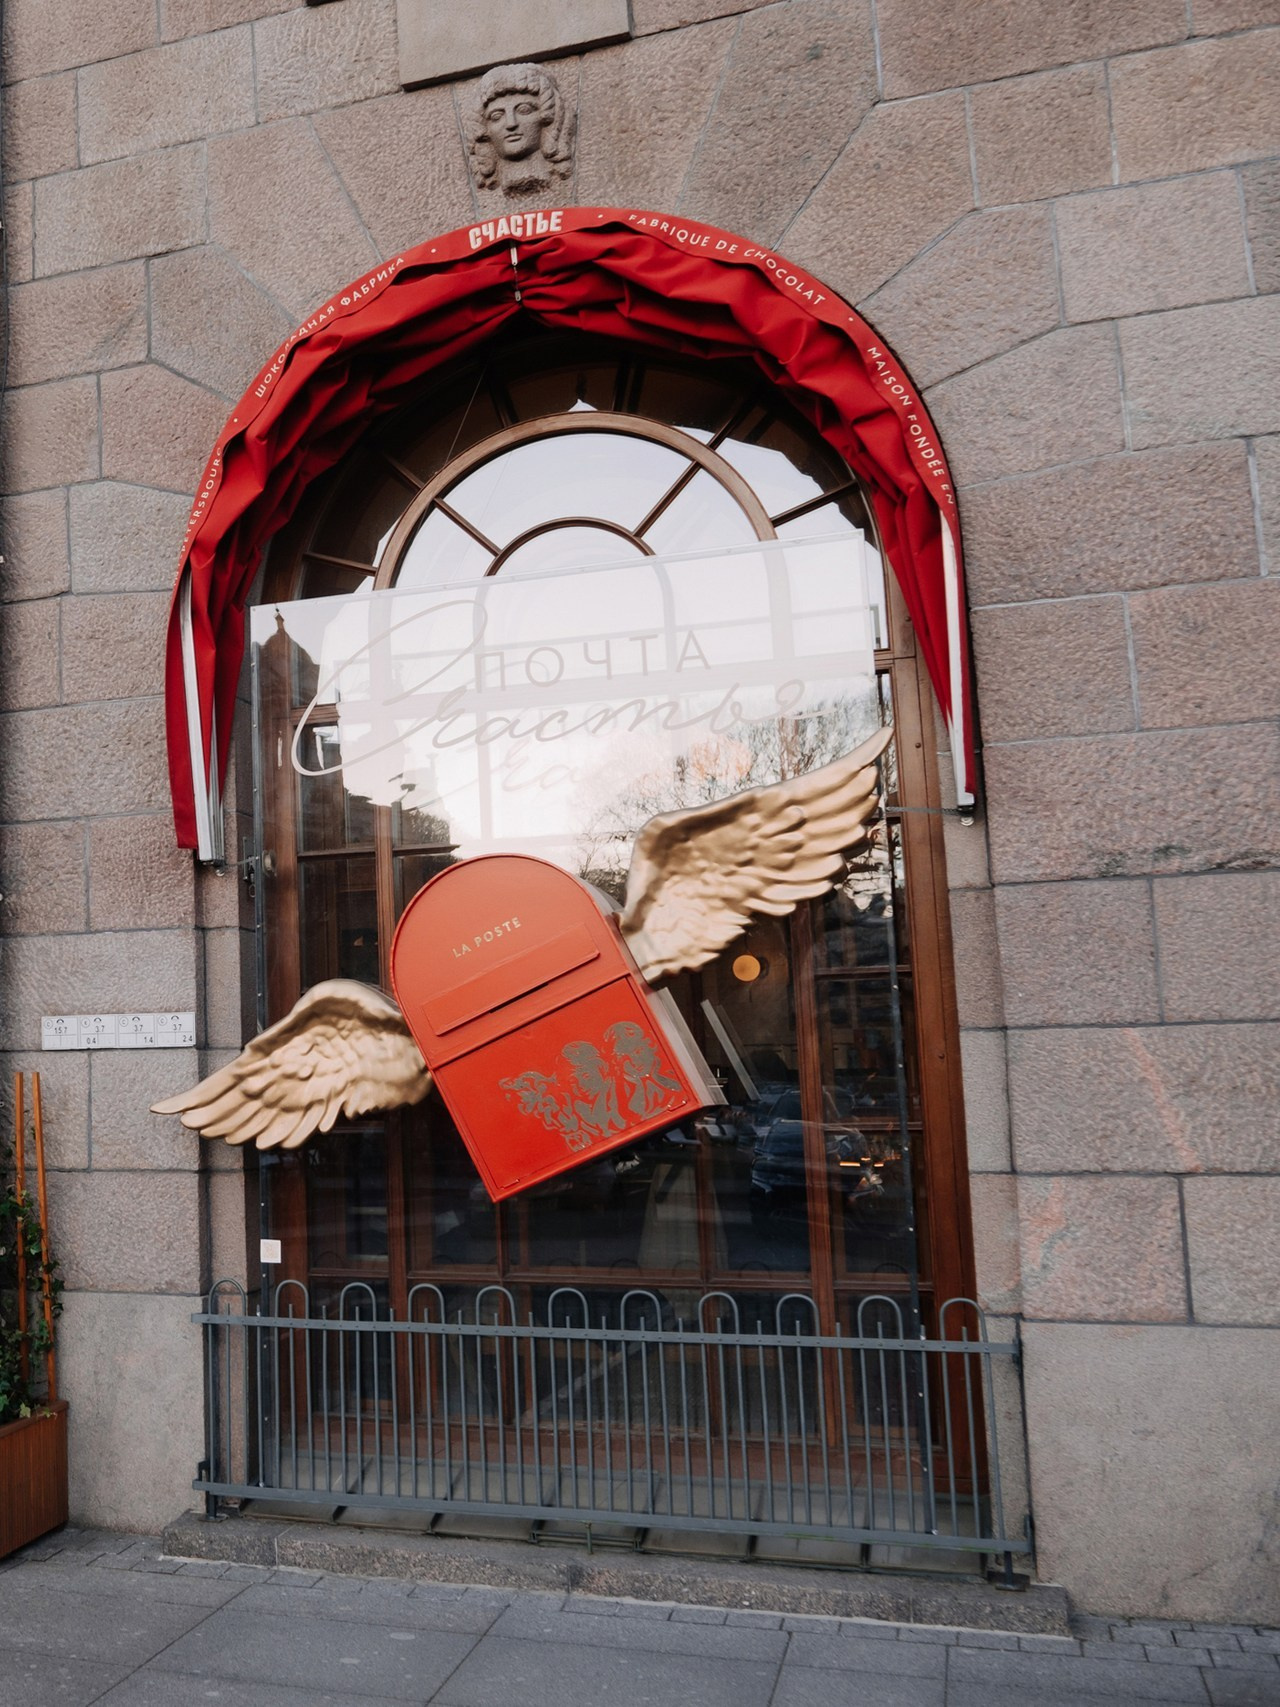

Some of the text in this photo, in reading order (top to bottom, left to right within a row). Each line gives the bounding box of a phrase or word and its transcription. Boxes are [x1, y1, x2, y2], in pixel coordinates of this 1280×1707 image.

[468, 211, 564, 250] СЧАСТЬЕ
[340, 257, 404, 307] ФАБРИКА
[628, 214, 826, 305] FABRIQUE DE CHOCOLAT
[867, 346, 913, 407] MAISON
[474, 629, 711, 694] ПОЧТА
[452, 916, 522, 958] LA POSTE
